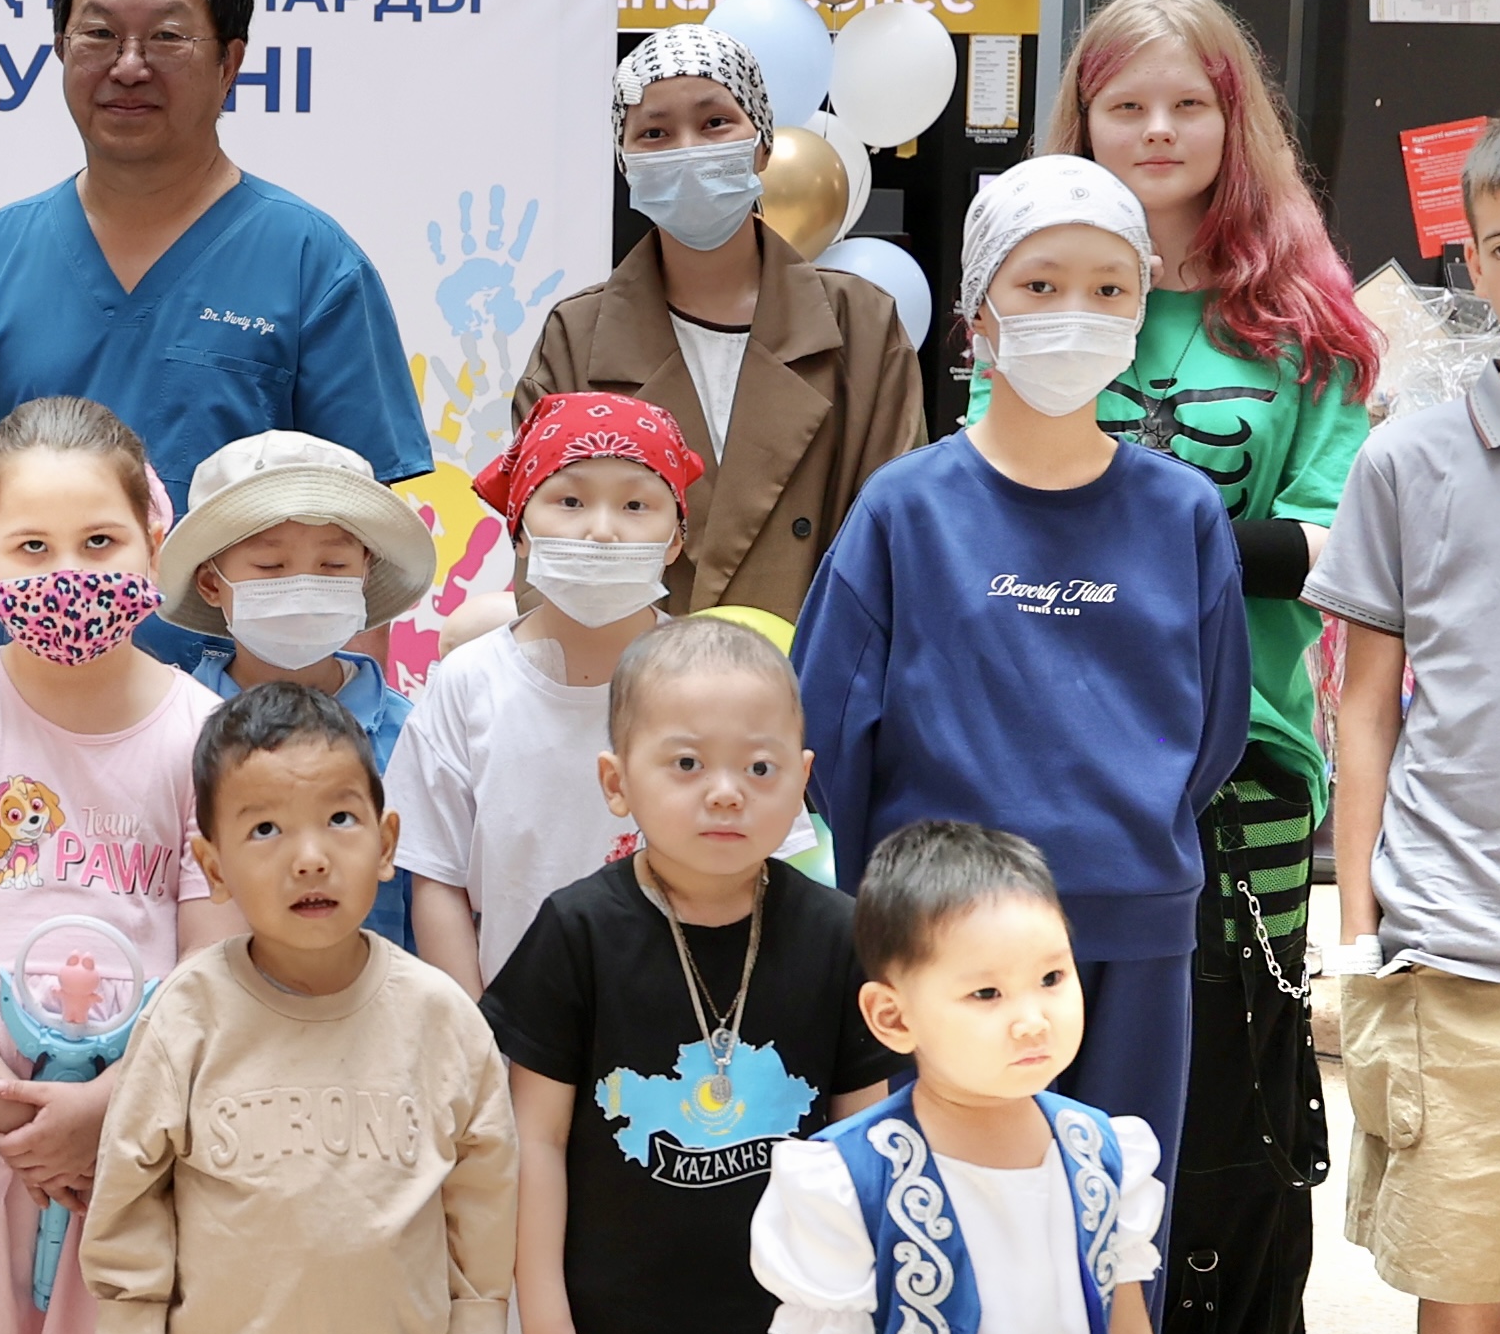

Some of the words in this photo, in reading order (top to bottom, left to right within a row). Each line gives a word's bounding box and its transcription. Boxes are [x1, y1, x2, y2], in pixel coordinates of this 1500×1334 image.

[200, 308, 220, 321] Dr.
[987, 574, 1061, 607] Beverly
[1062, 579, 1118, 603] Hills
[1017, 603, 1051, 615] TENNIS
[1054, 607, 1081, 616] CLUB
[81, 805, 140, 838] Team
[55, 830, 173, 897] PAW!
[208, 1085, 421, 1168] STRONG
